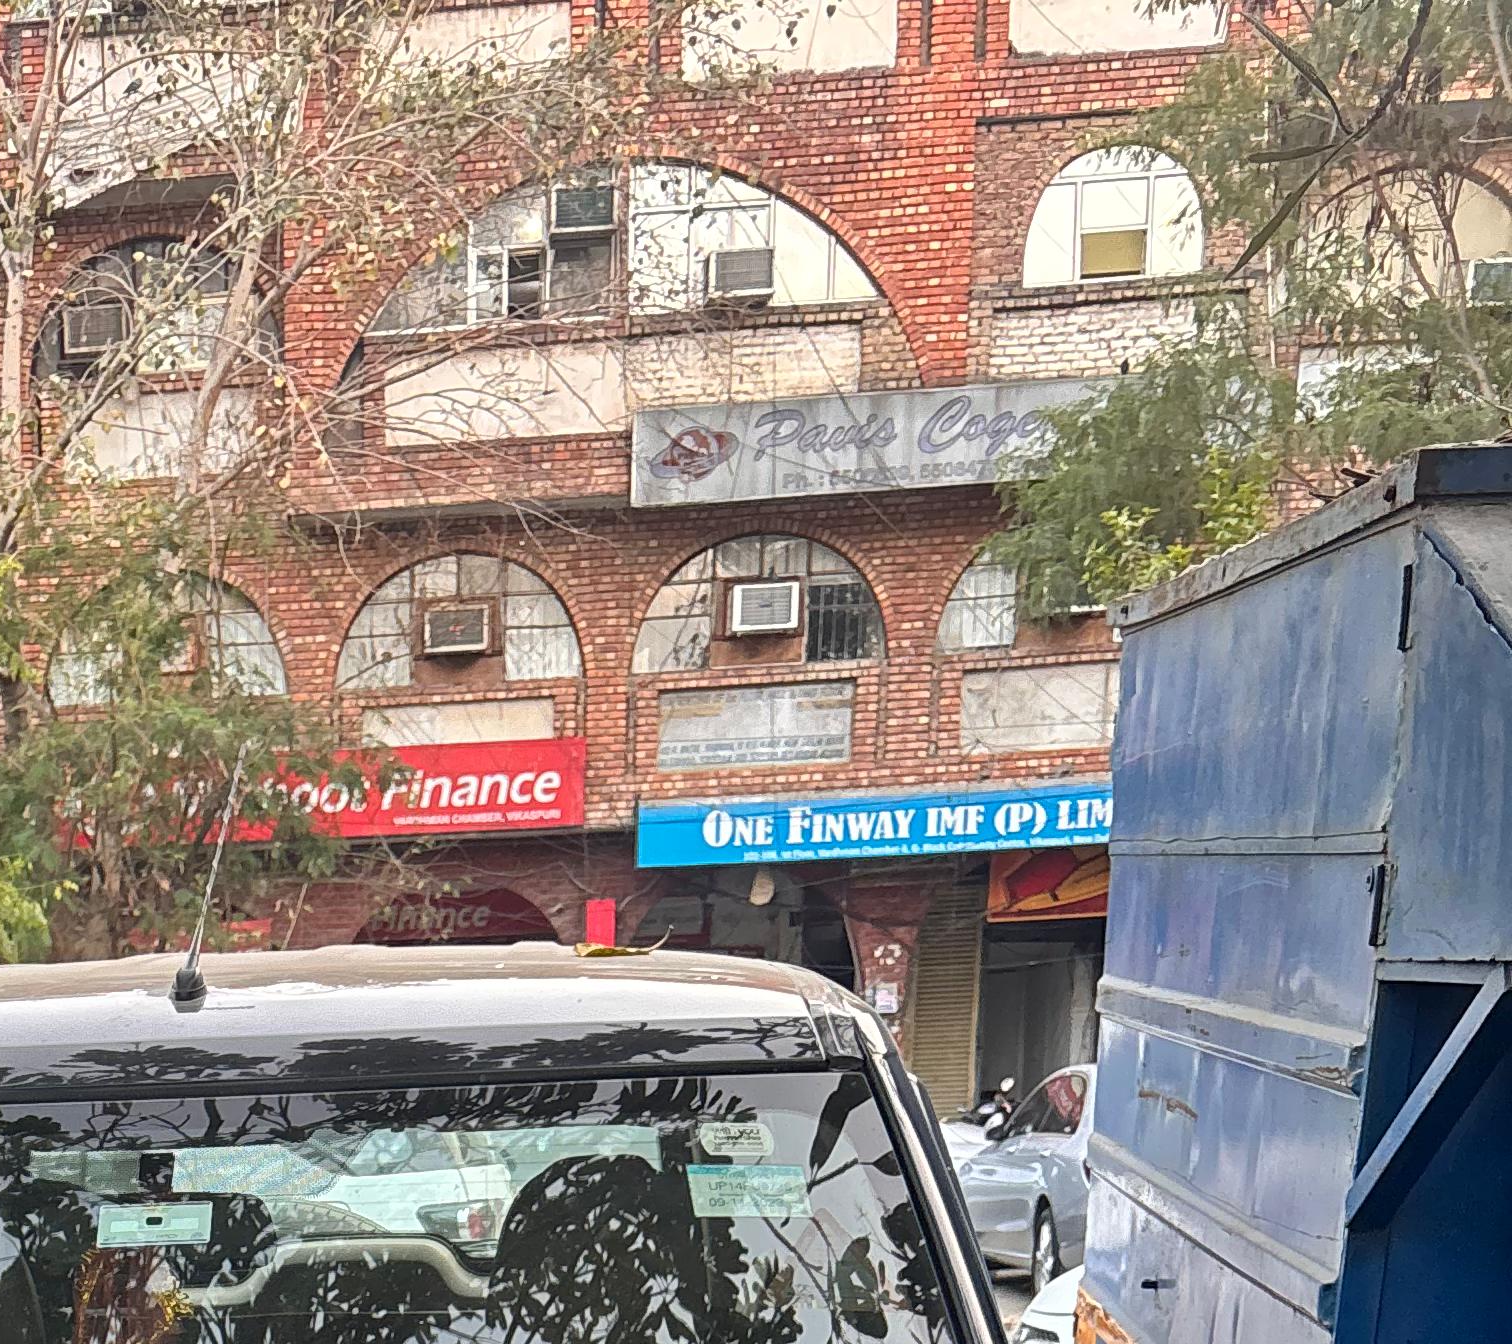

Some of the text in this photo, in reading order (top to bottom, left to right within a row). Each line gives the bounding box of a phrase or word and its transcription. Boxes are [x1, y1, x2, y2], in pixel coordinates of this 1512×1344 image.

[381, 770, 561, 811] Finance
[786, 806, 916, 845] FINWAY
[924, 805, 986, 838] IMF
[994, 801, 1048, 836] (P)
